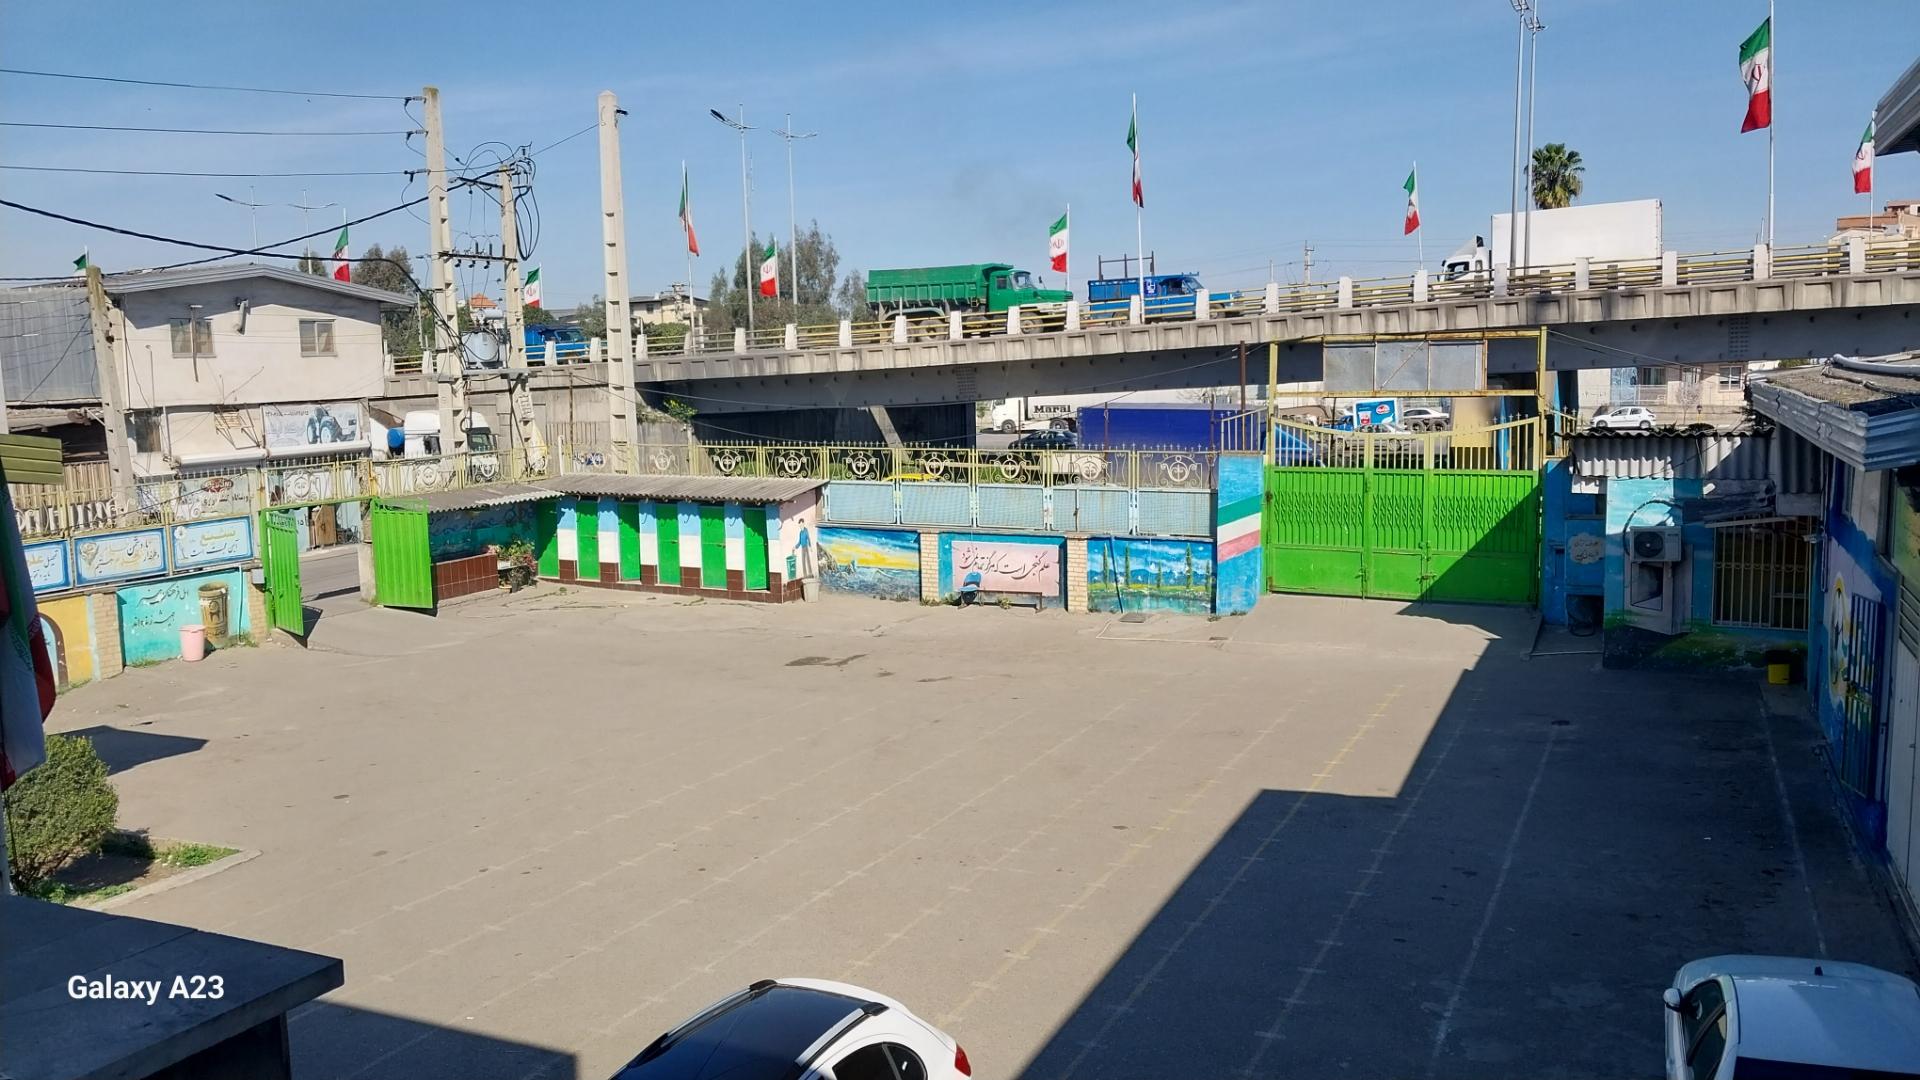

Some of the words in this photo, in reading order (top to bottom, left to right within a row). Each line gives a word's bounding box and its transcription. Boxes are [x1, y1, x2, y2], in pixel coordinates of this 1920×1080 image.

[1033, 405, 1071, 414] Maral
[999, 564, 1026, 575] است
[1038, 562, 1050, 580] علم
